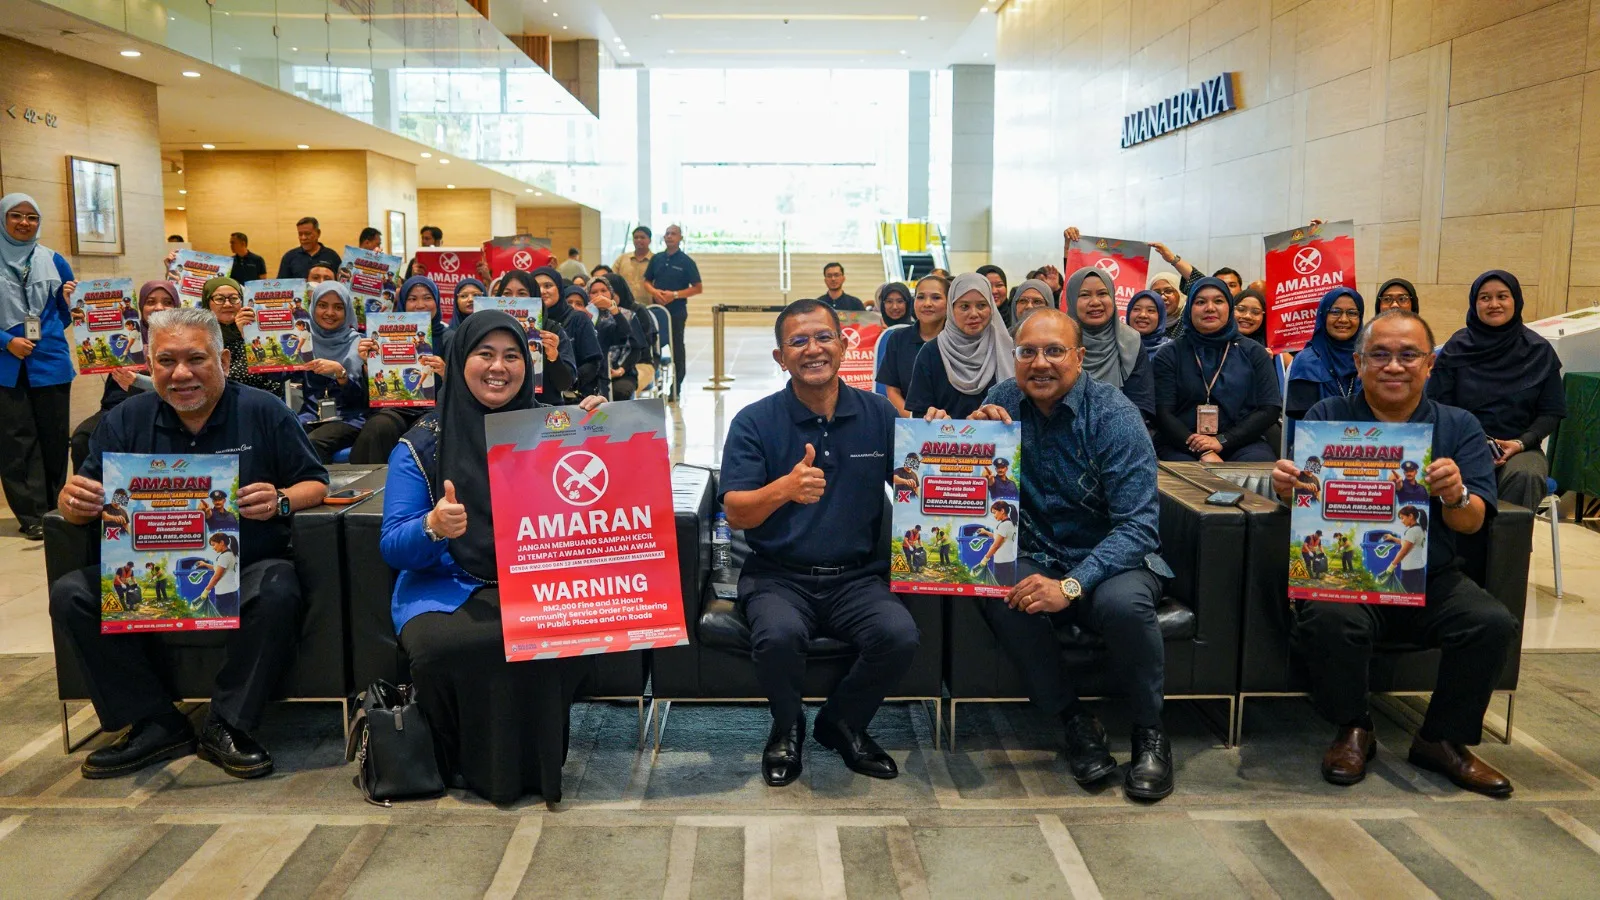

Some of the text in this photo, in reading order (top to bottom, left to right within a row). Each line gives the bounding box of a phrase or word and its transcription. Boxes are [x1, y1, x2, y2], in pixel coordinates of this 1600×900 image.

[1121, 72, 1232, 148] AMANAHRAYA
[1276, 270, 1343, 294] AMARAN
[1281, 308, 1318, 323] WARN
[844, 350, 875, 360] ARAN
[840, 374, 873, 382] ARNIN
[920, 441, 995, 457] AMARAN
[1322, 444, 1403, 460] AMARAN
[129, 476, 211, 491] AMARAN
[517, 505, 652, 541] AMARAN
[517, 533, 653, 552] JANGAN MEMBUANG SAMPAH KECIL
[528, 552, 557, 561] TEMPAT
[559, 548, 585, 558] AWAM
[586, 547, 603, 555] DAN
[604, 544, 629, 553] JALAN
[630, 542, 656, 550] AWAM
[532, 573, 648, 603] WARNING
[520, 612, 567, 622] Community
[569, 609, 598, 618] Service
[599, 607, 621, 615] Order
[636, 602, 668, 611] Littering
[543, 603, 576, 613] RM2,000
[577, 601, 594, 609] Fine
[620, 597, 643, 605] Hours
[546, 619, 571, 628] Public
[572, 617, 598, 626] Places
[599, 616, 615, 624] and
[628, 612, 653, 620] Roads
